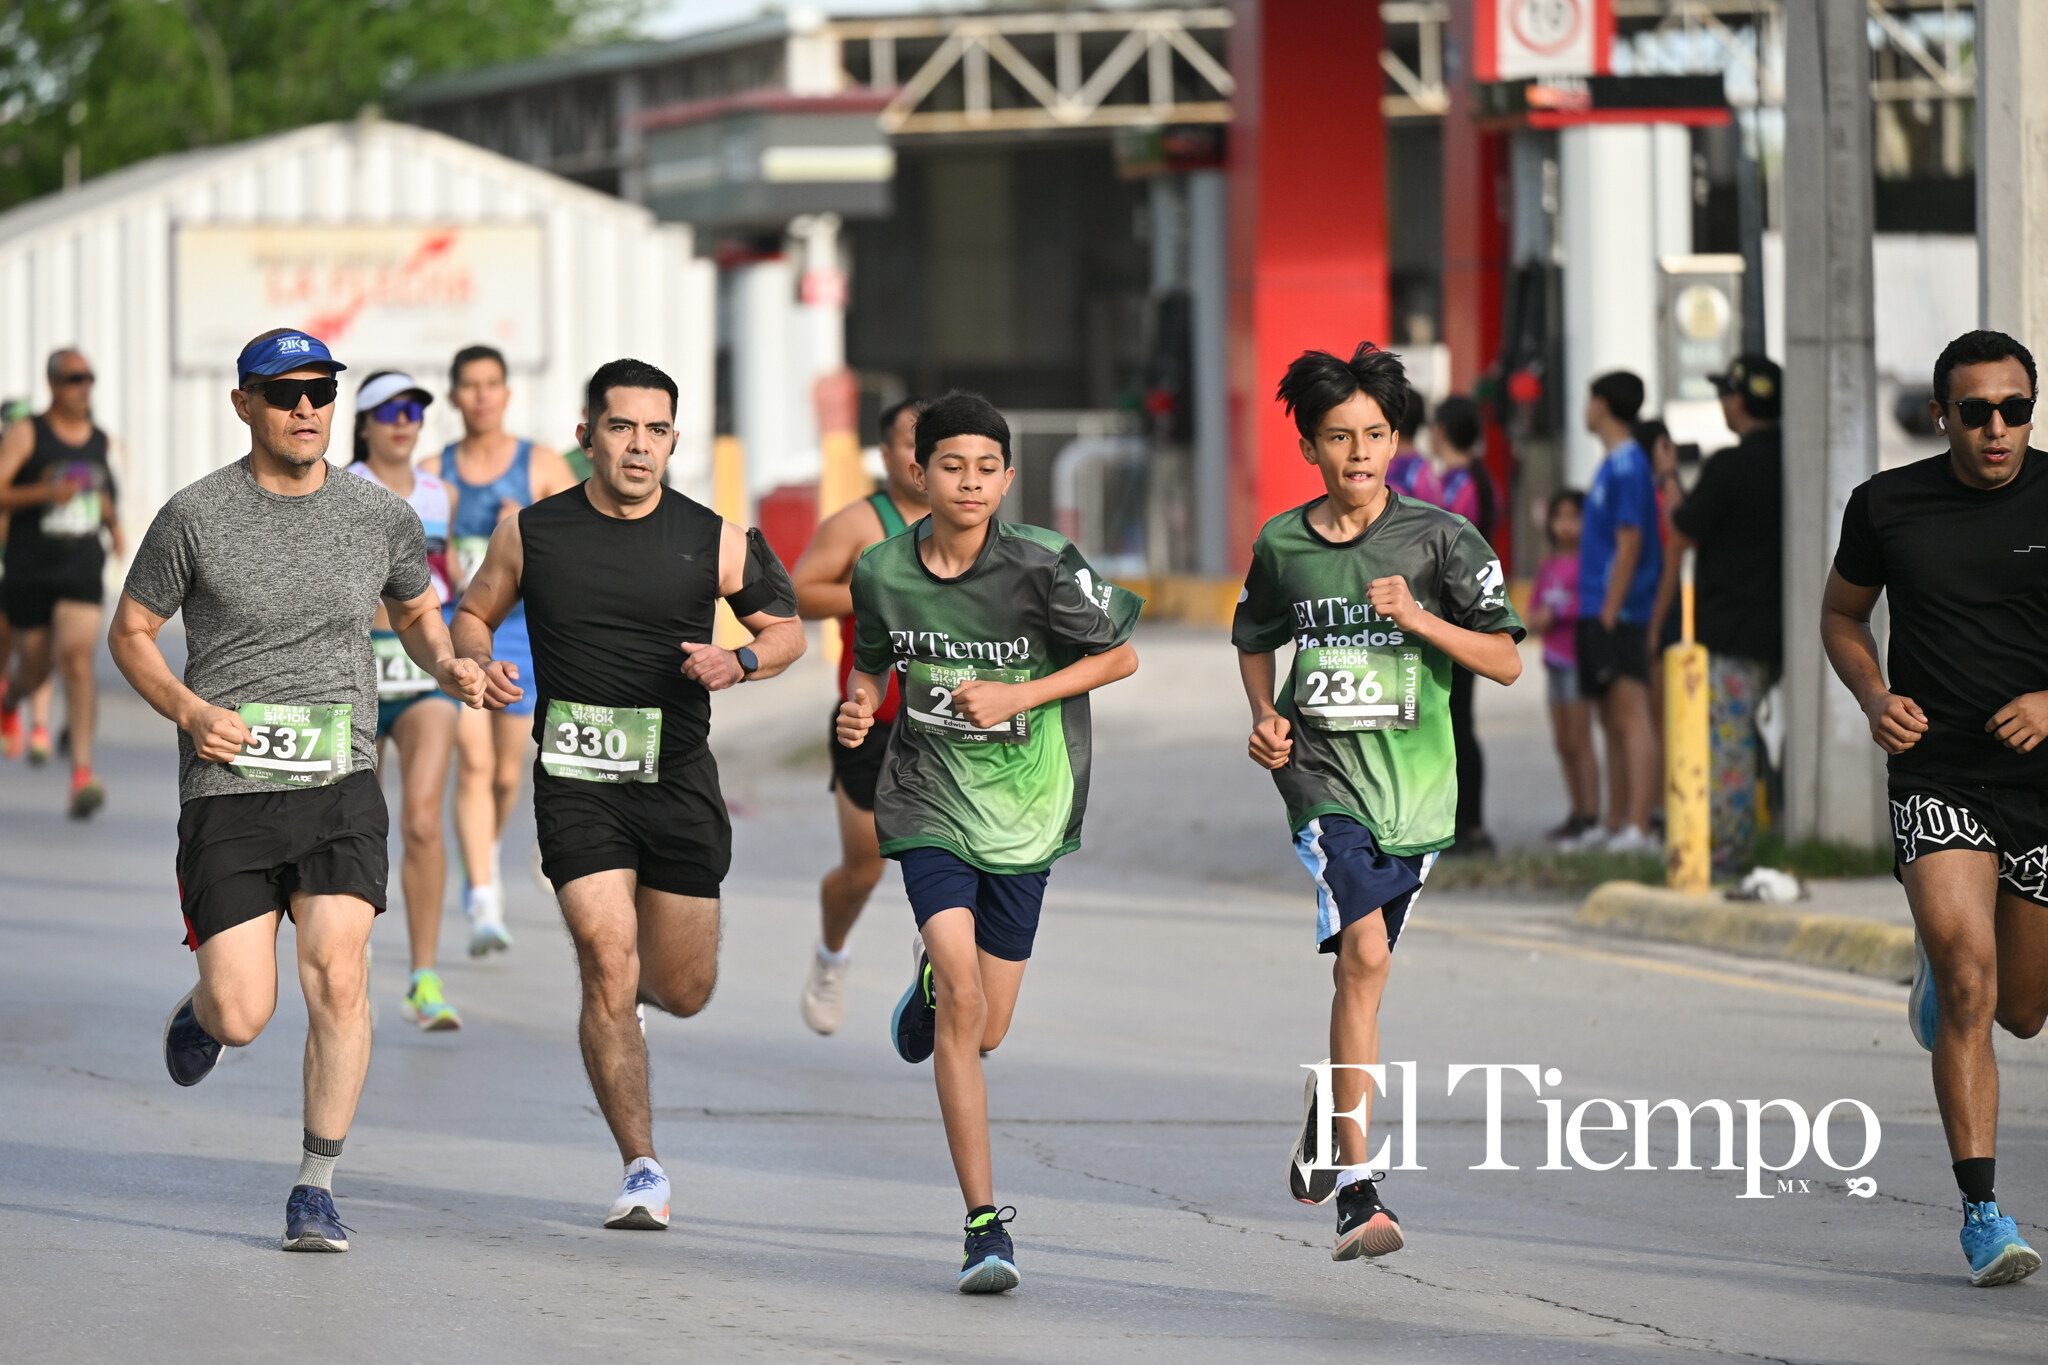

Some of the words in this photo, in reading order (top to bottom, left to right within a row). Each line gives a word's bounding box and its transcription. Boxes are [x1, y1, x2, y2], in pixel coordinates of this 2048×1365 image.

[1293, 600, 1318, 630] El
[888, 630, 919, 656] El
[919, 631, 1029, 667] Tiempo
[1324, 629, 1404, 648] todos
[930, 667, 977, 676] CARRERA
[1403, 653, 1419, 661] 236
[1306, 670, 1383, 705] 236
[1404, 666, 1416, 721] MEDALLA
[264, 705, 311, 714] CARRERA
[572, 704, 614, 715] CARRERA
[943, 719, 967, 729] Edwin
[246, 725, 322, 760] 537
[336, 721, 346, 775] MEDALLA
[556, 722, 627, 760] 330
[644, 725, 657, 774] MEDALLA
